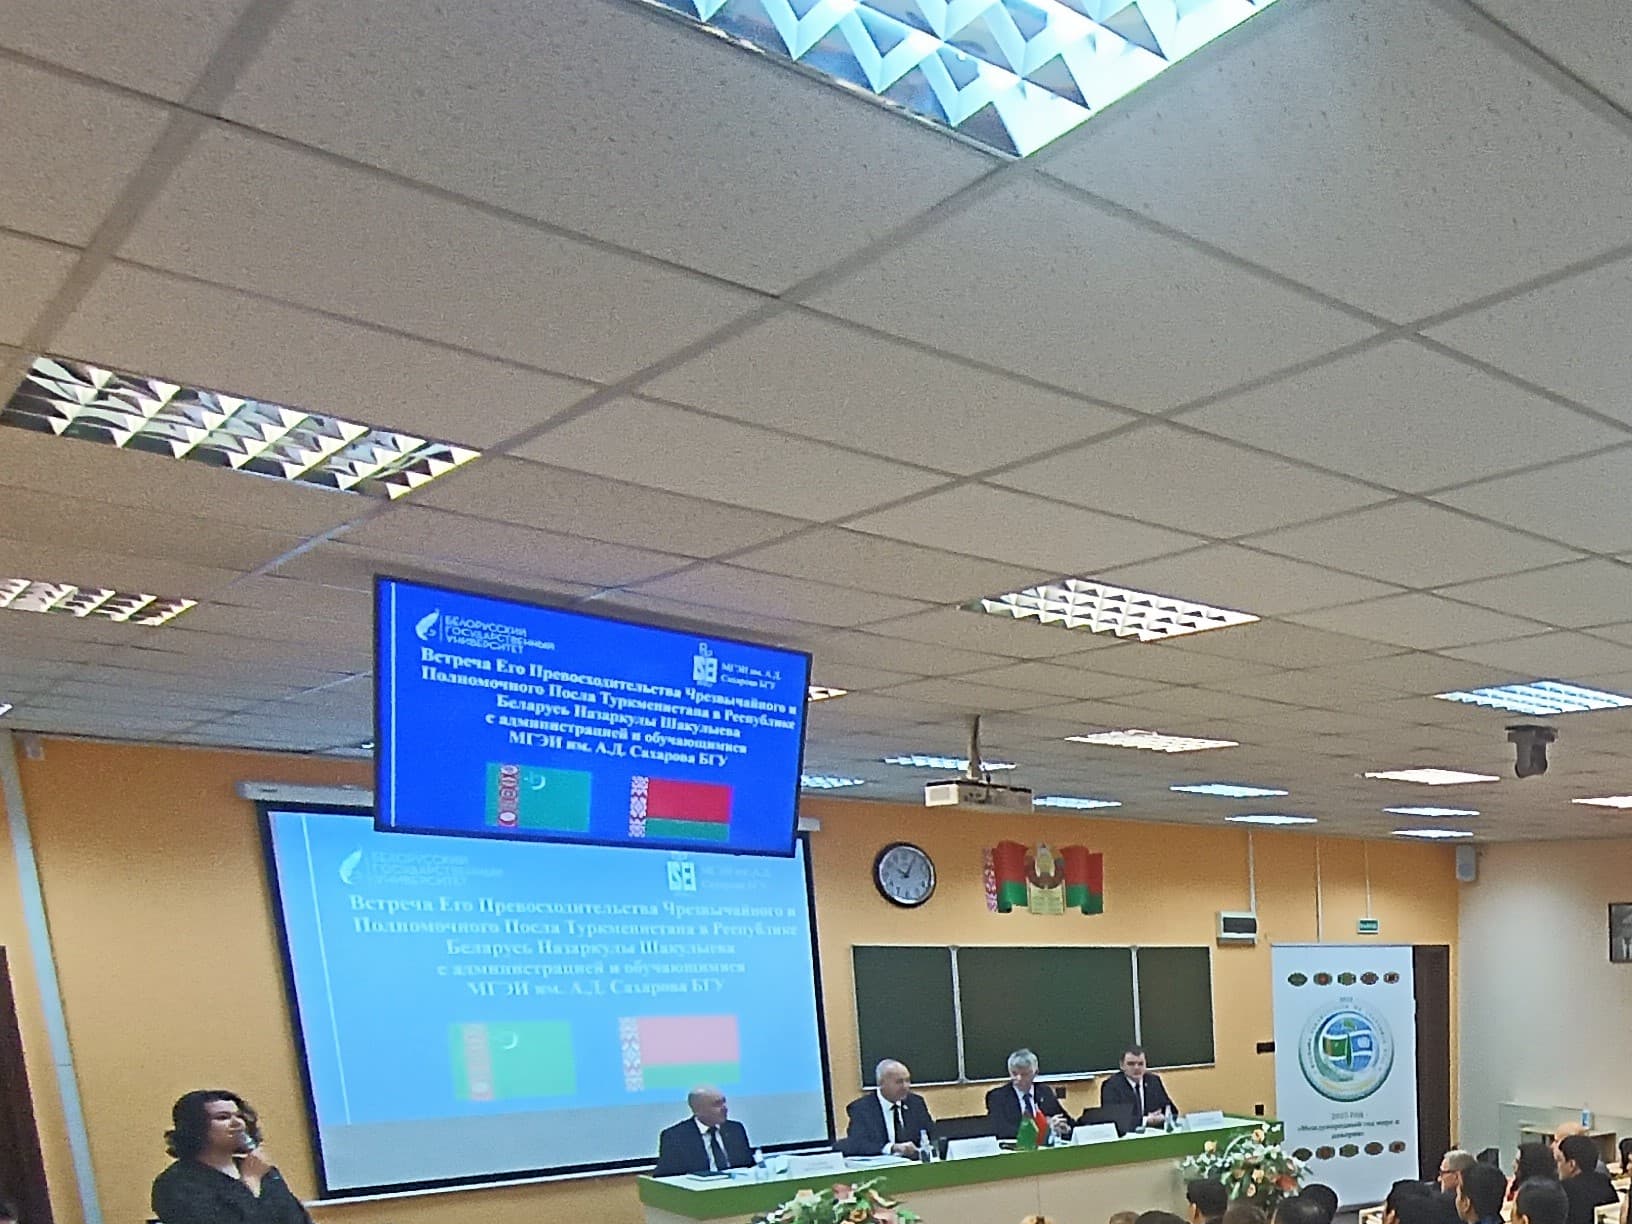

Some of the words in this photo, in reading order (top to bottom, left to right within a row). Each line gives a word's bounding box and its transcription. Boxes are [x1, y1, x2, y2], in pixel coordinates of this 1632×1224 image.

[421, 646, 492, 671] Встреча
[496, 658, 526, 675] Его
[529, 663, 682, 698] Превосходительства
[685, 686, 786, 713] Чрезвычайного
[788, 705, 797, 715] и
[421, 665, 545, 695] Полномочного
[548, 683, 597, 703] Посла
[599, 691, 710, 719] Туркменистана
[712, 709, 721, 720] в
[724, 708, 796, 730] Республике
[496, 693, 570, 717] Беларусь
[485, 713, 496, 724] с
[498, 715, 629, 740] администрацией
[631, 731, 641, 741] и
[644, 731, 747, 754] обучающимися
[509, 730, 563, 749] МГЭИ
[629, 744, 696, 765] Сахарова
[698, 752, 728, 767] БГУ
[348, 894, 434, 915] Встреча
[439, 896, 474, 912] Его
[479, 897, 659, 917] Превосходительства
[352, 916, 500, 933] Полномочного
[504, 918, 560, 935] Посла
[566, 919, 695, 938] Туркменистана
[713, 921, 798, 938] Республике
[446, 938, 533, 957] Беларусь
[436, 964, 447, 976] с
[453, 961, 604, 978] администрацией
[609, 964, 619, 974] и
[624, 959, 746, 977] обучающимися
[609, 978, 688, 996] Сахарова
[692, 977, 724, 993] БГУ
